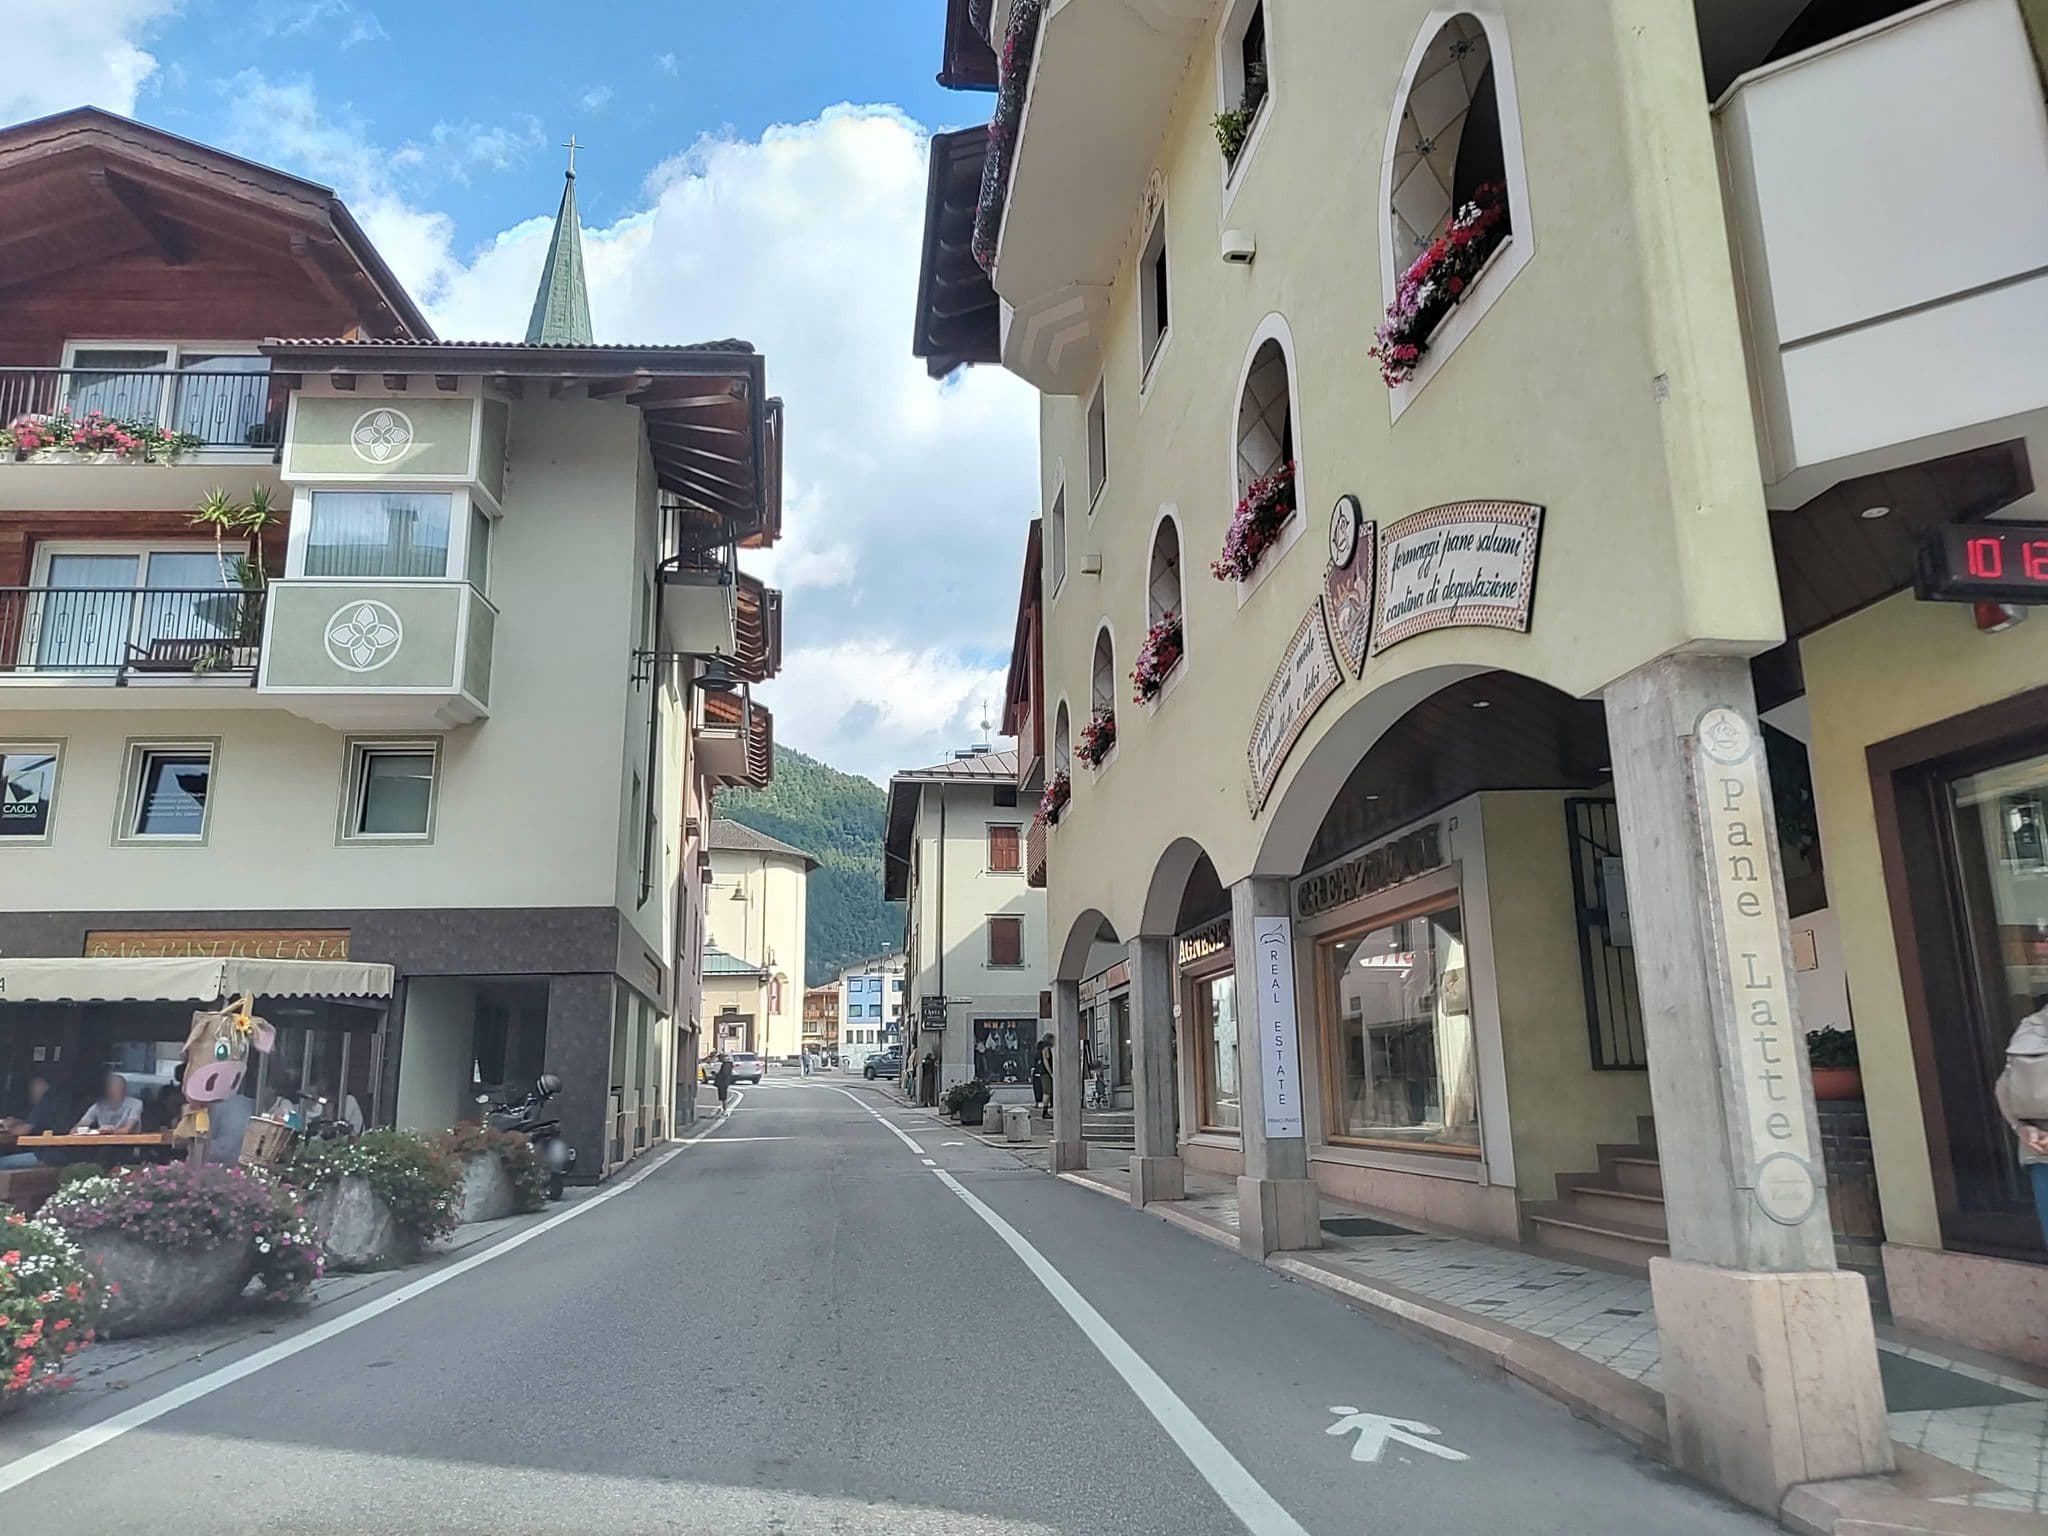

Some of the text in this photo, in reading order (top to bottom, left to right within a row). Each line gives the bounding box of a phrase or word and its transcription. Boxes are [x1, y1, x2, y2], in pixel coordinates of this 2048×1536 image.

[1391, 524, 1525, 593] formaggi pane salumi
[1967, 537, 2002, 577] 10
[1386, 567, 1518, 623] cantina di degustazione
[2, 804, 38, 814] CAOLA
[93, 939, 349, 960] BAR PASTICCERIA
[1719, 778, 1792, 1140] Pane Latte
[1270, 950, 1286, 1105] REAL ESTATE
